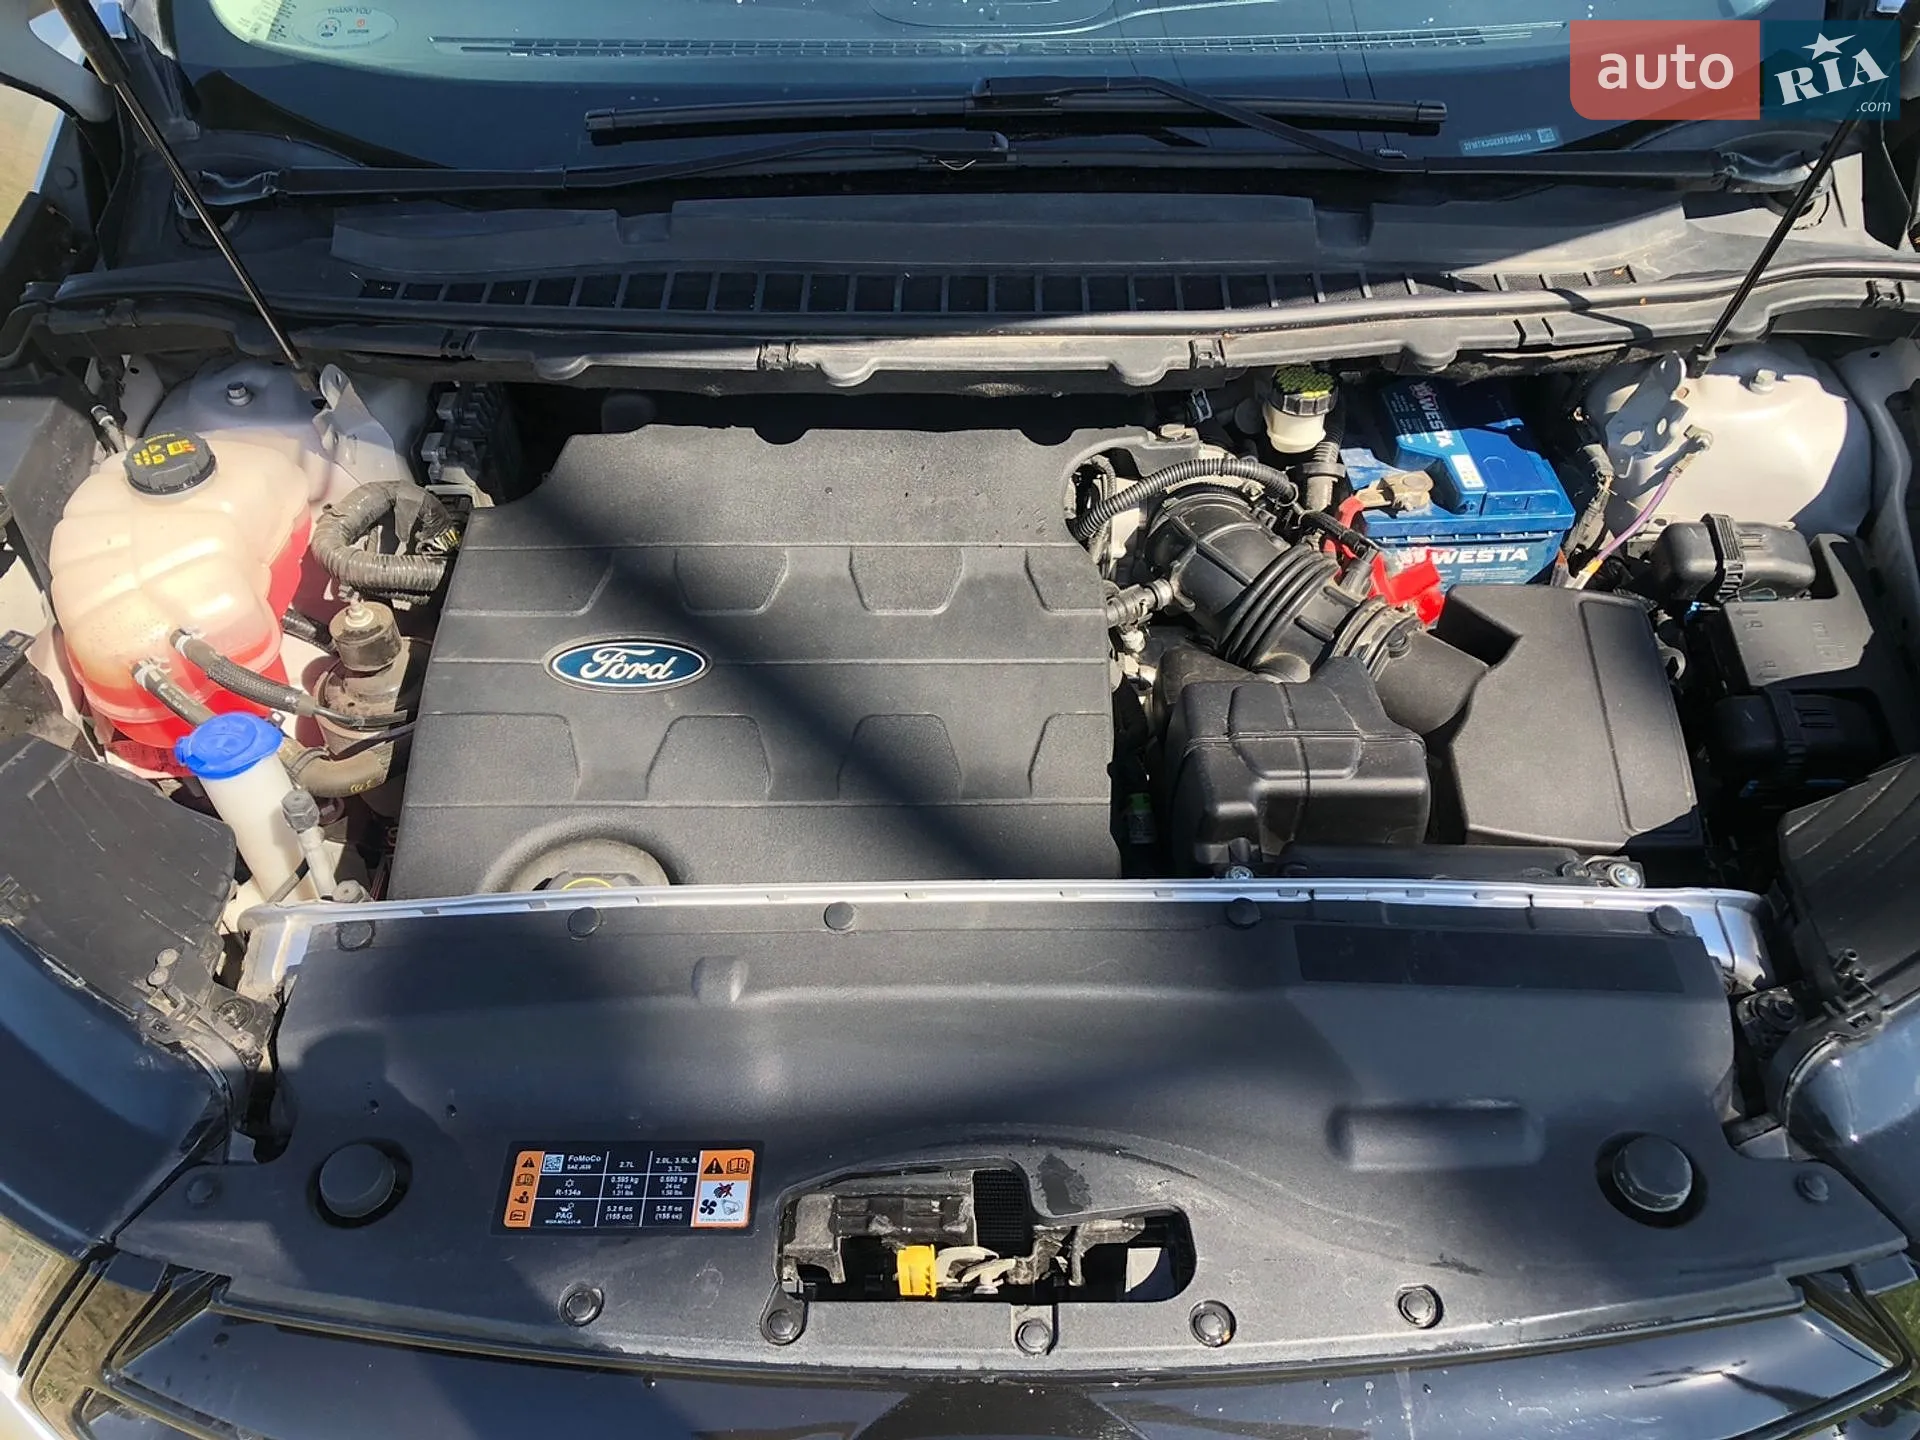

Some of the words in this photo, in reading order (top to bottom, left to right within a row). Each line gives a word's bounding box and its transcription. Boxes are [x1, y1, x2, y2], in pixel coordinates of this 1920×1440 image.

[327, 7, 353, 15] THANK
[1431, 547, 1529, 564] WESTA
[580, 647, 678, 680] Ford
[630, 1176, 640, 1184] kg
[679, 1176, 688, 1184] kg
